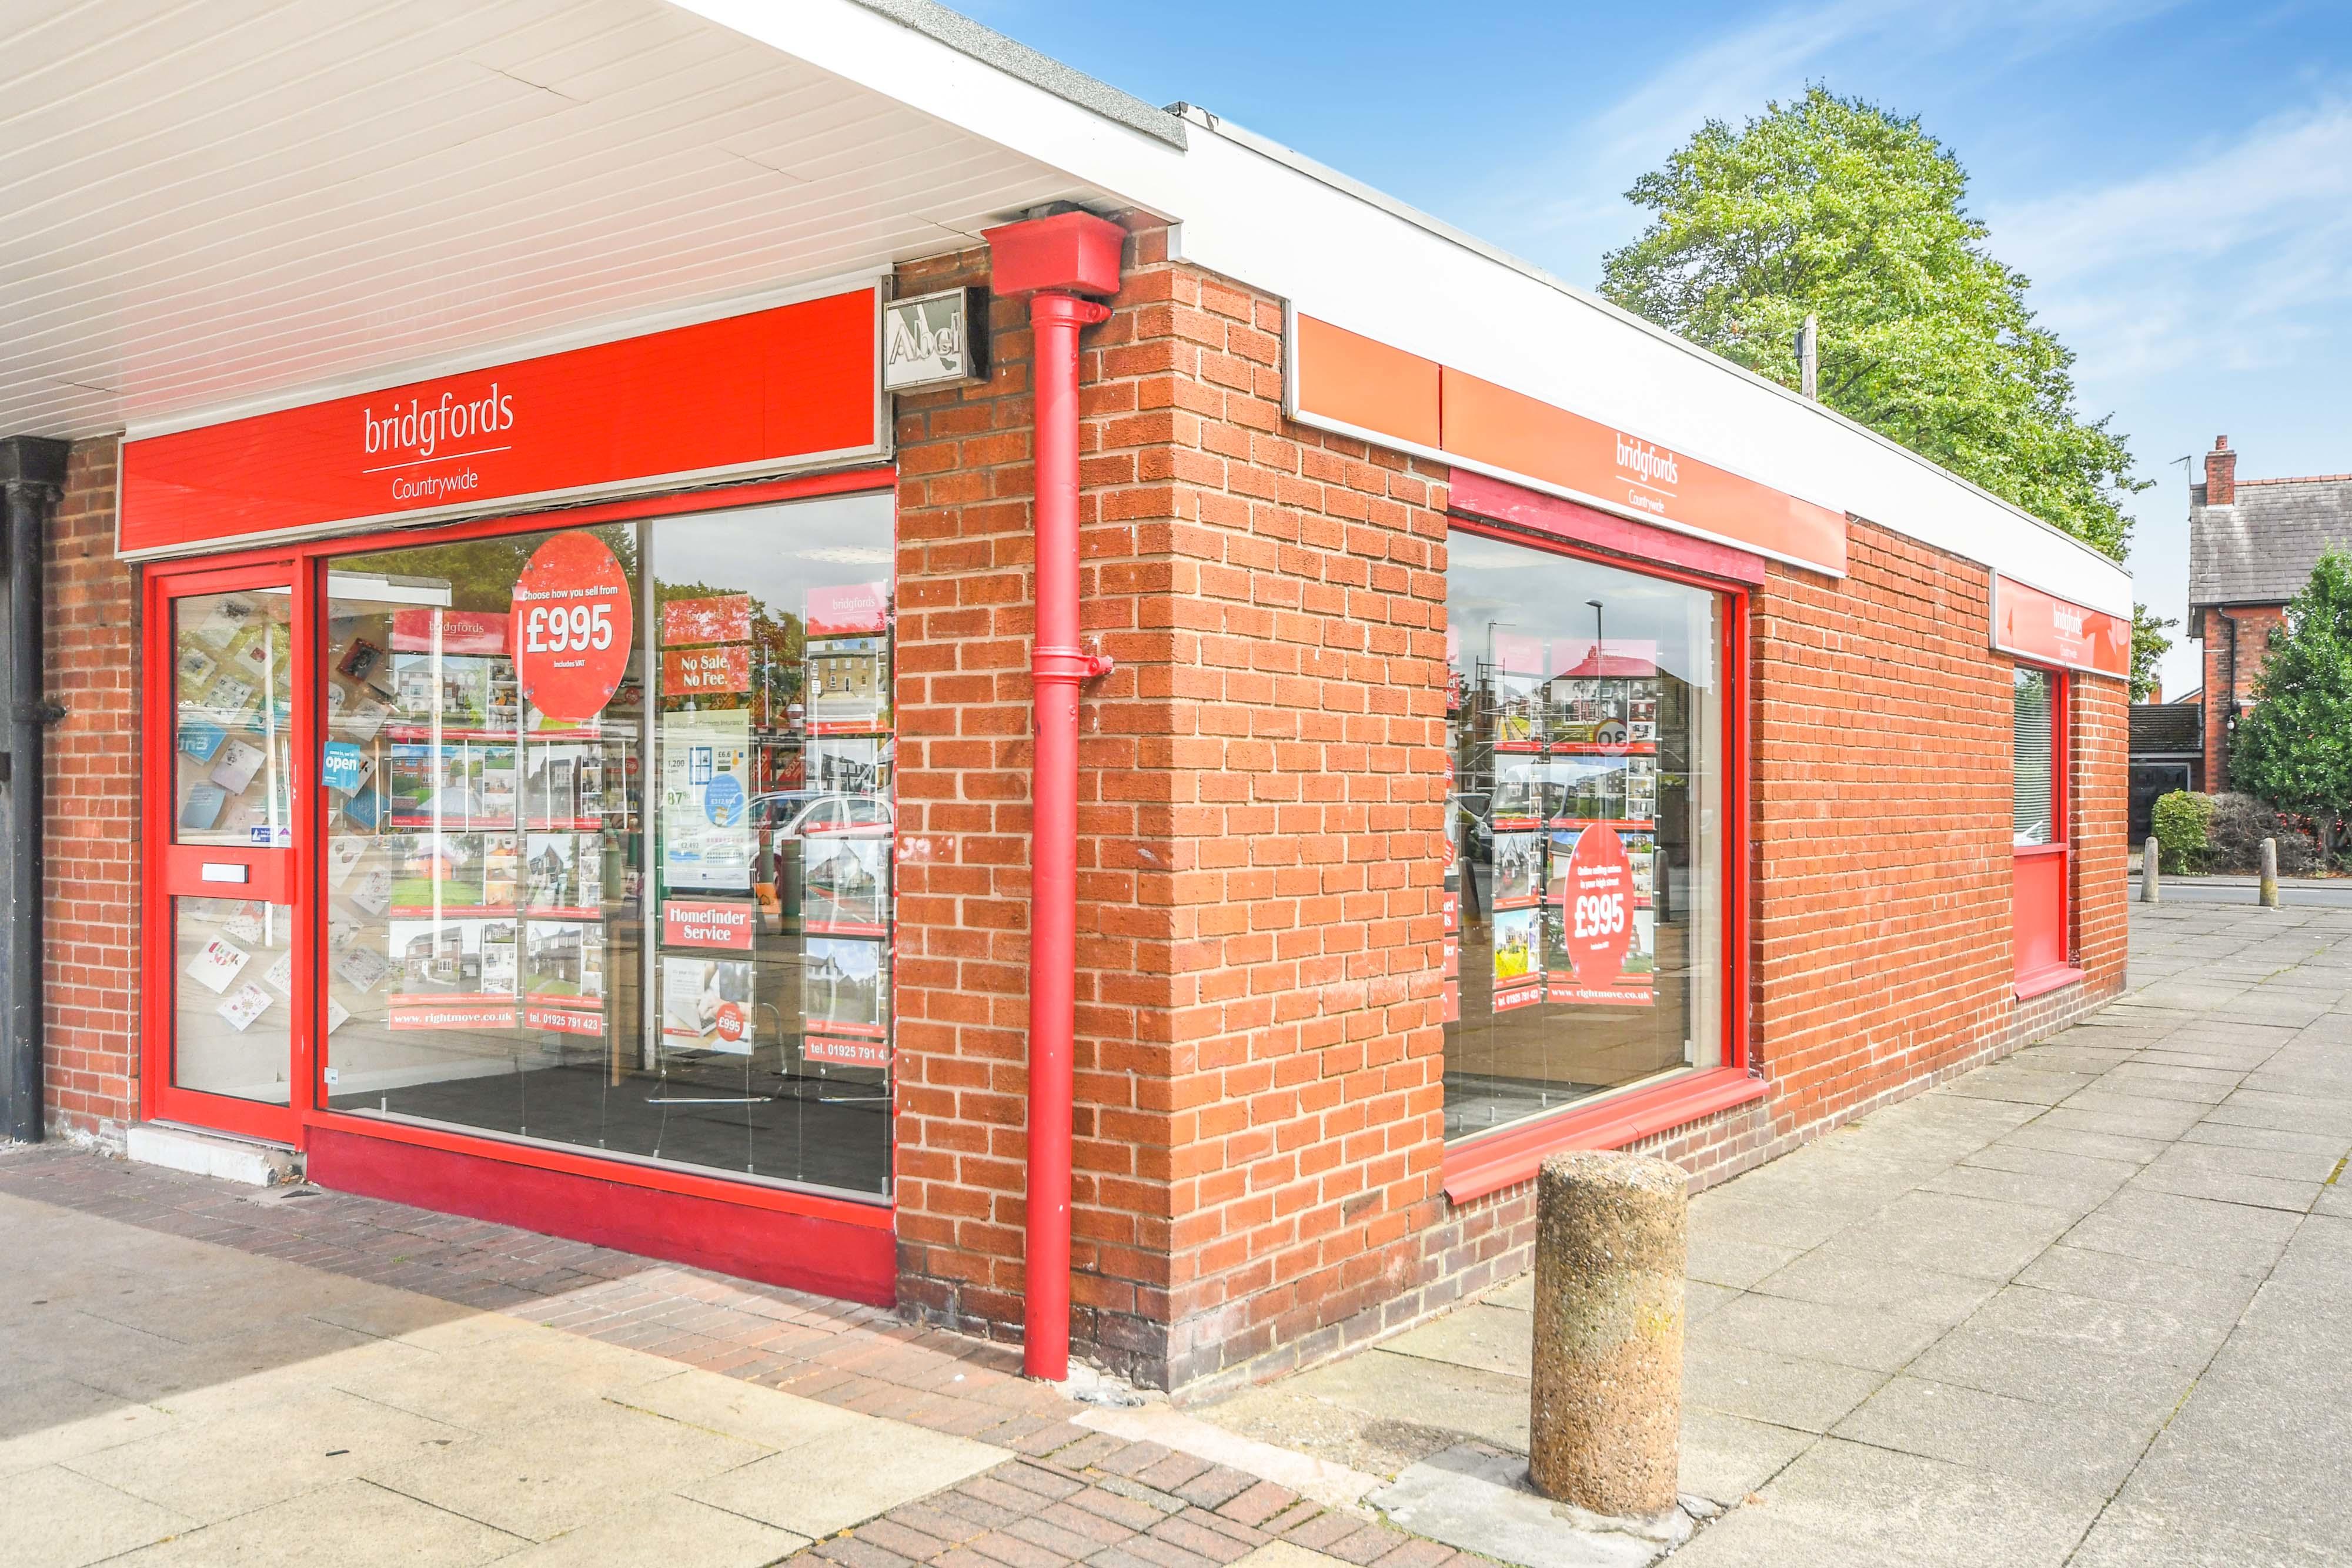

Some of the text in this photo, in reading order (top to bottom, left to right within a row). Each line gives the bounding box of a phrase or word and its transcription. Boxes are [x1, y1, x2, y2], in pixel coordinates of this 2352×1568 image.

[363, 382, 514, 456] bridgfords
[1616, 433, 1678, 484] bridgfords
[392, 467, 479, 501] Countrywide
[1629, 489, 1665, 513] Countrywide
[522, 585, 618, 600] Choose how you sell from
[833, 597, 875, 611] bridgfords
[429, 620, 485, 634] bdgfords
[526, 604, 613, 653] £995
[574, 659, 586, 667] VAT
[681, 655, 730, 670] No Sale,
[684, 672, 727, 687] No Fee.
[326, 756, 357, 773] open
[670, 908, 746, 926] Homefinder
[1574, 893, 1625, 938] £995
[684, 925, 731, 941] Service
[1576, 988, 1650, 999] rightmove.co.uk
[425, 1012, 512, 1024] rightmove.co.uk
[530, 1012, 598, 1030] tel. 01925 791 423
[718, 1016, 741, 1032] £995
[811, 1042, 826, 1054] tel.
[828, 1044, 856, 1057] 01925
[858, 1047, 875, 1059] 791
